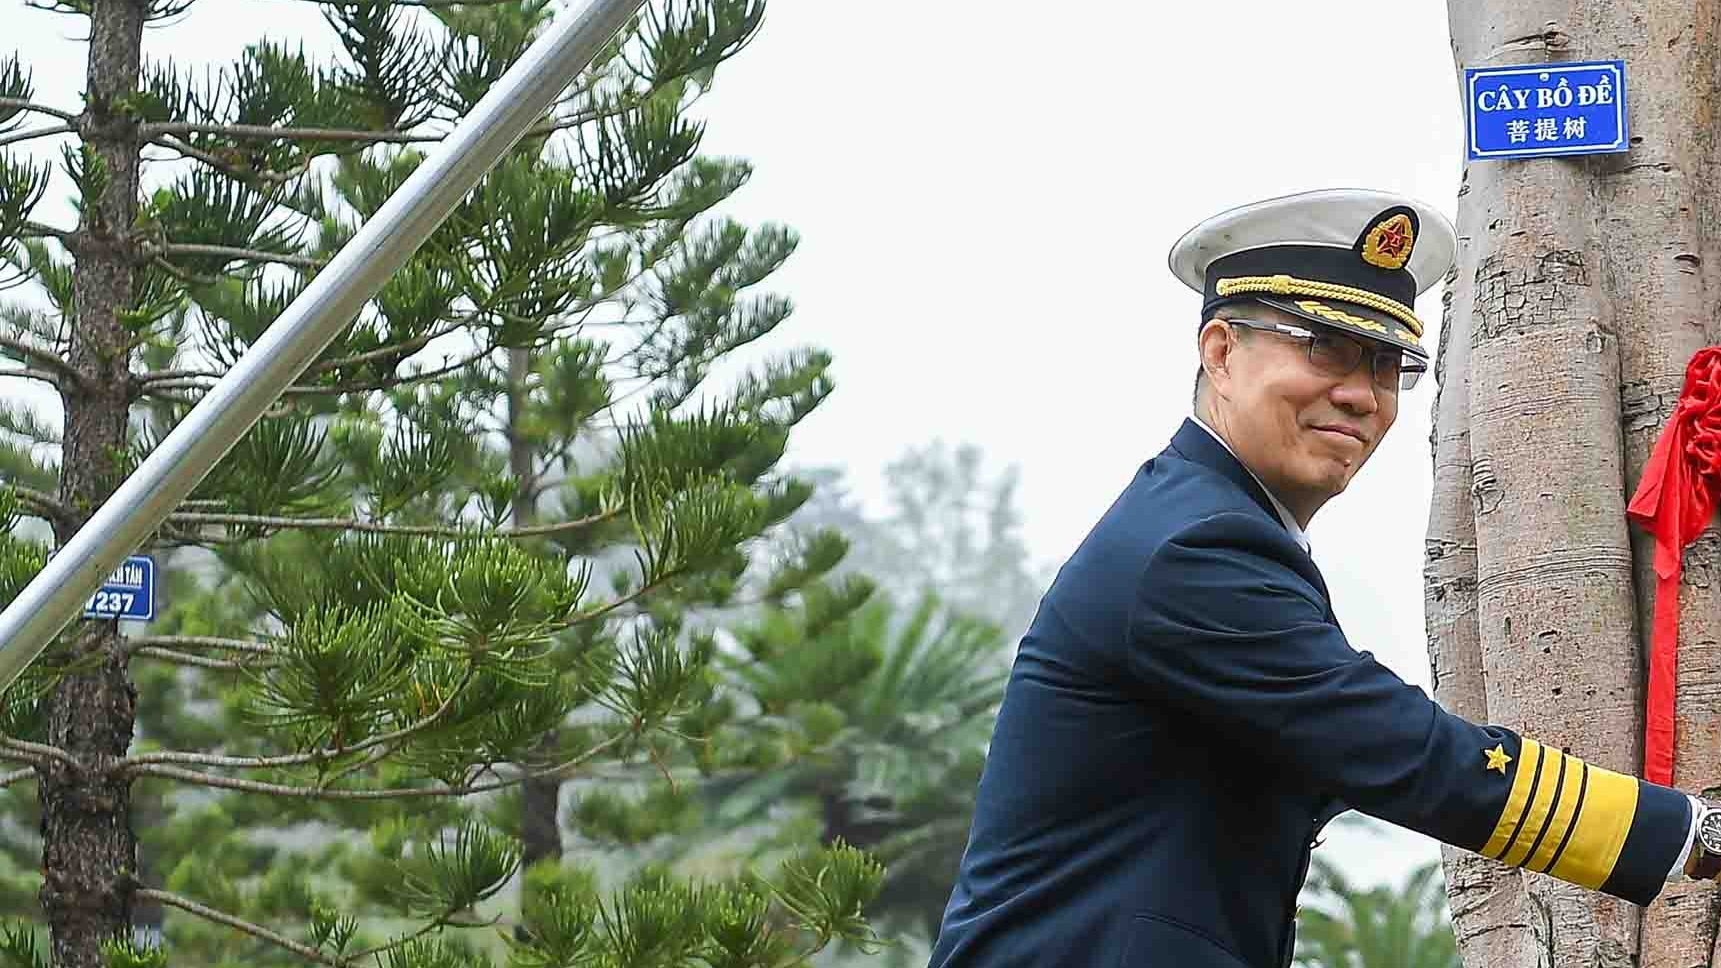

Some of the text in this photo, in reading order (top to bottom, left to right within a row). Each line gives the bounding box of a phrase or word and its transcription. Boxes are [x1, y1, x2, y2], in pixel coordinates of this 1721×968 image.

[1477, 75, 1613, 112] CÂY BỒ ĐỀ
[1506, 116, 1587, 143] 菩提树
